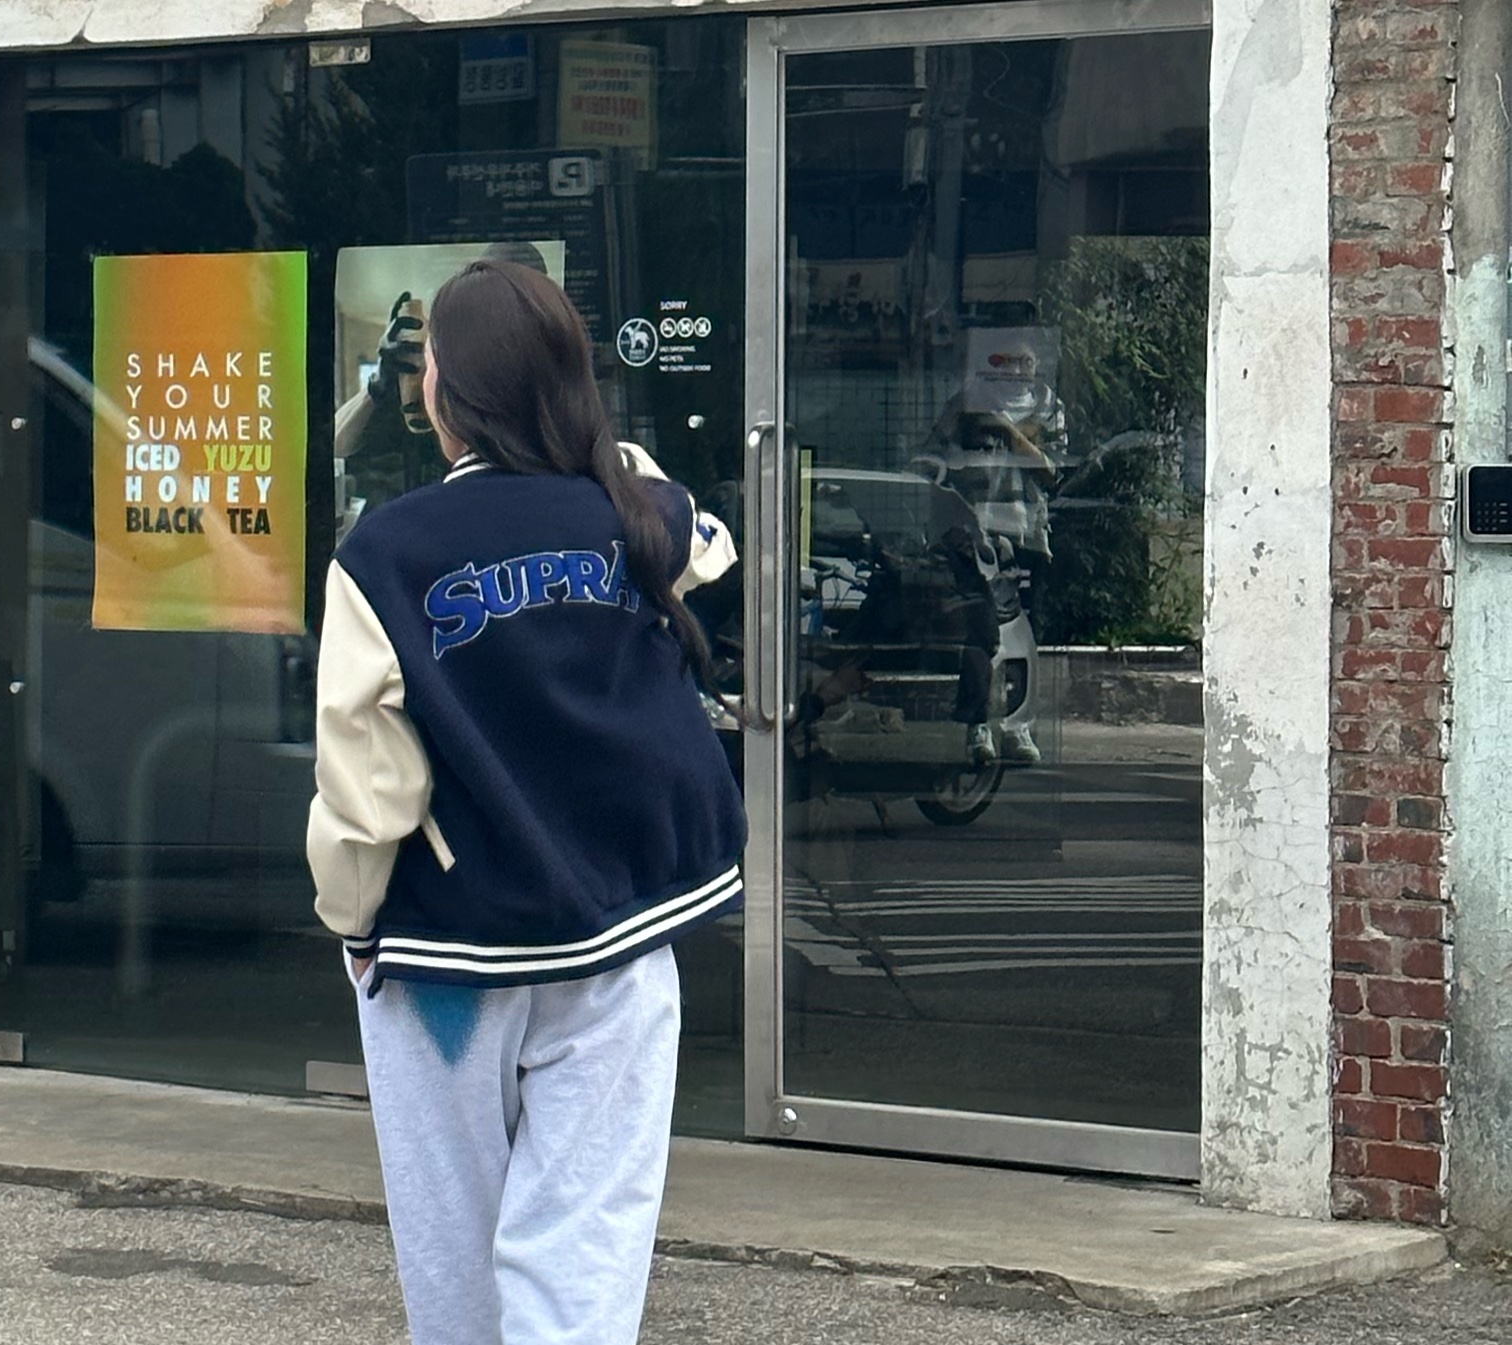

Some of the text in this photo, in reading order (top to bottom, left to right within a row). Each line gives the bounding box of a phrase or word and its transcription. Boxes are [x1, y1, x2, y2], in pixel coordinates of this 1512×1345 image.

[127, 352, 272, 378] SHAKE
[126, 384, 273, 409] YOUR
[127, 415, 273, 440] SUMMER
[126, 444, 272, 472] ICED YUZU
[125, 475, 272, 503] HONEY
[126, 506, 271, 535] BLACK TEA
